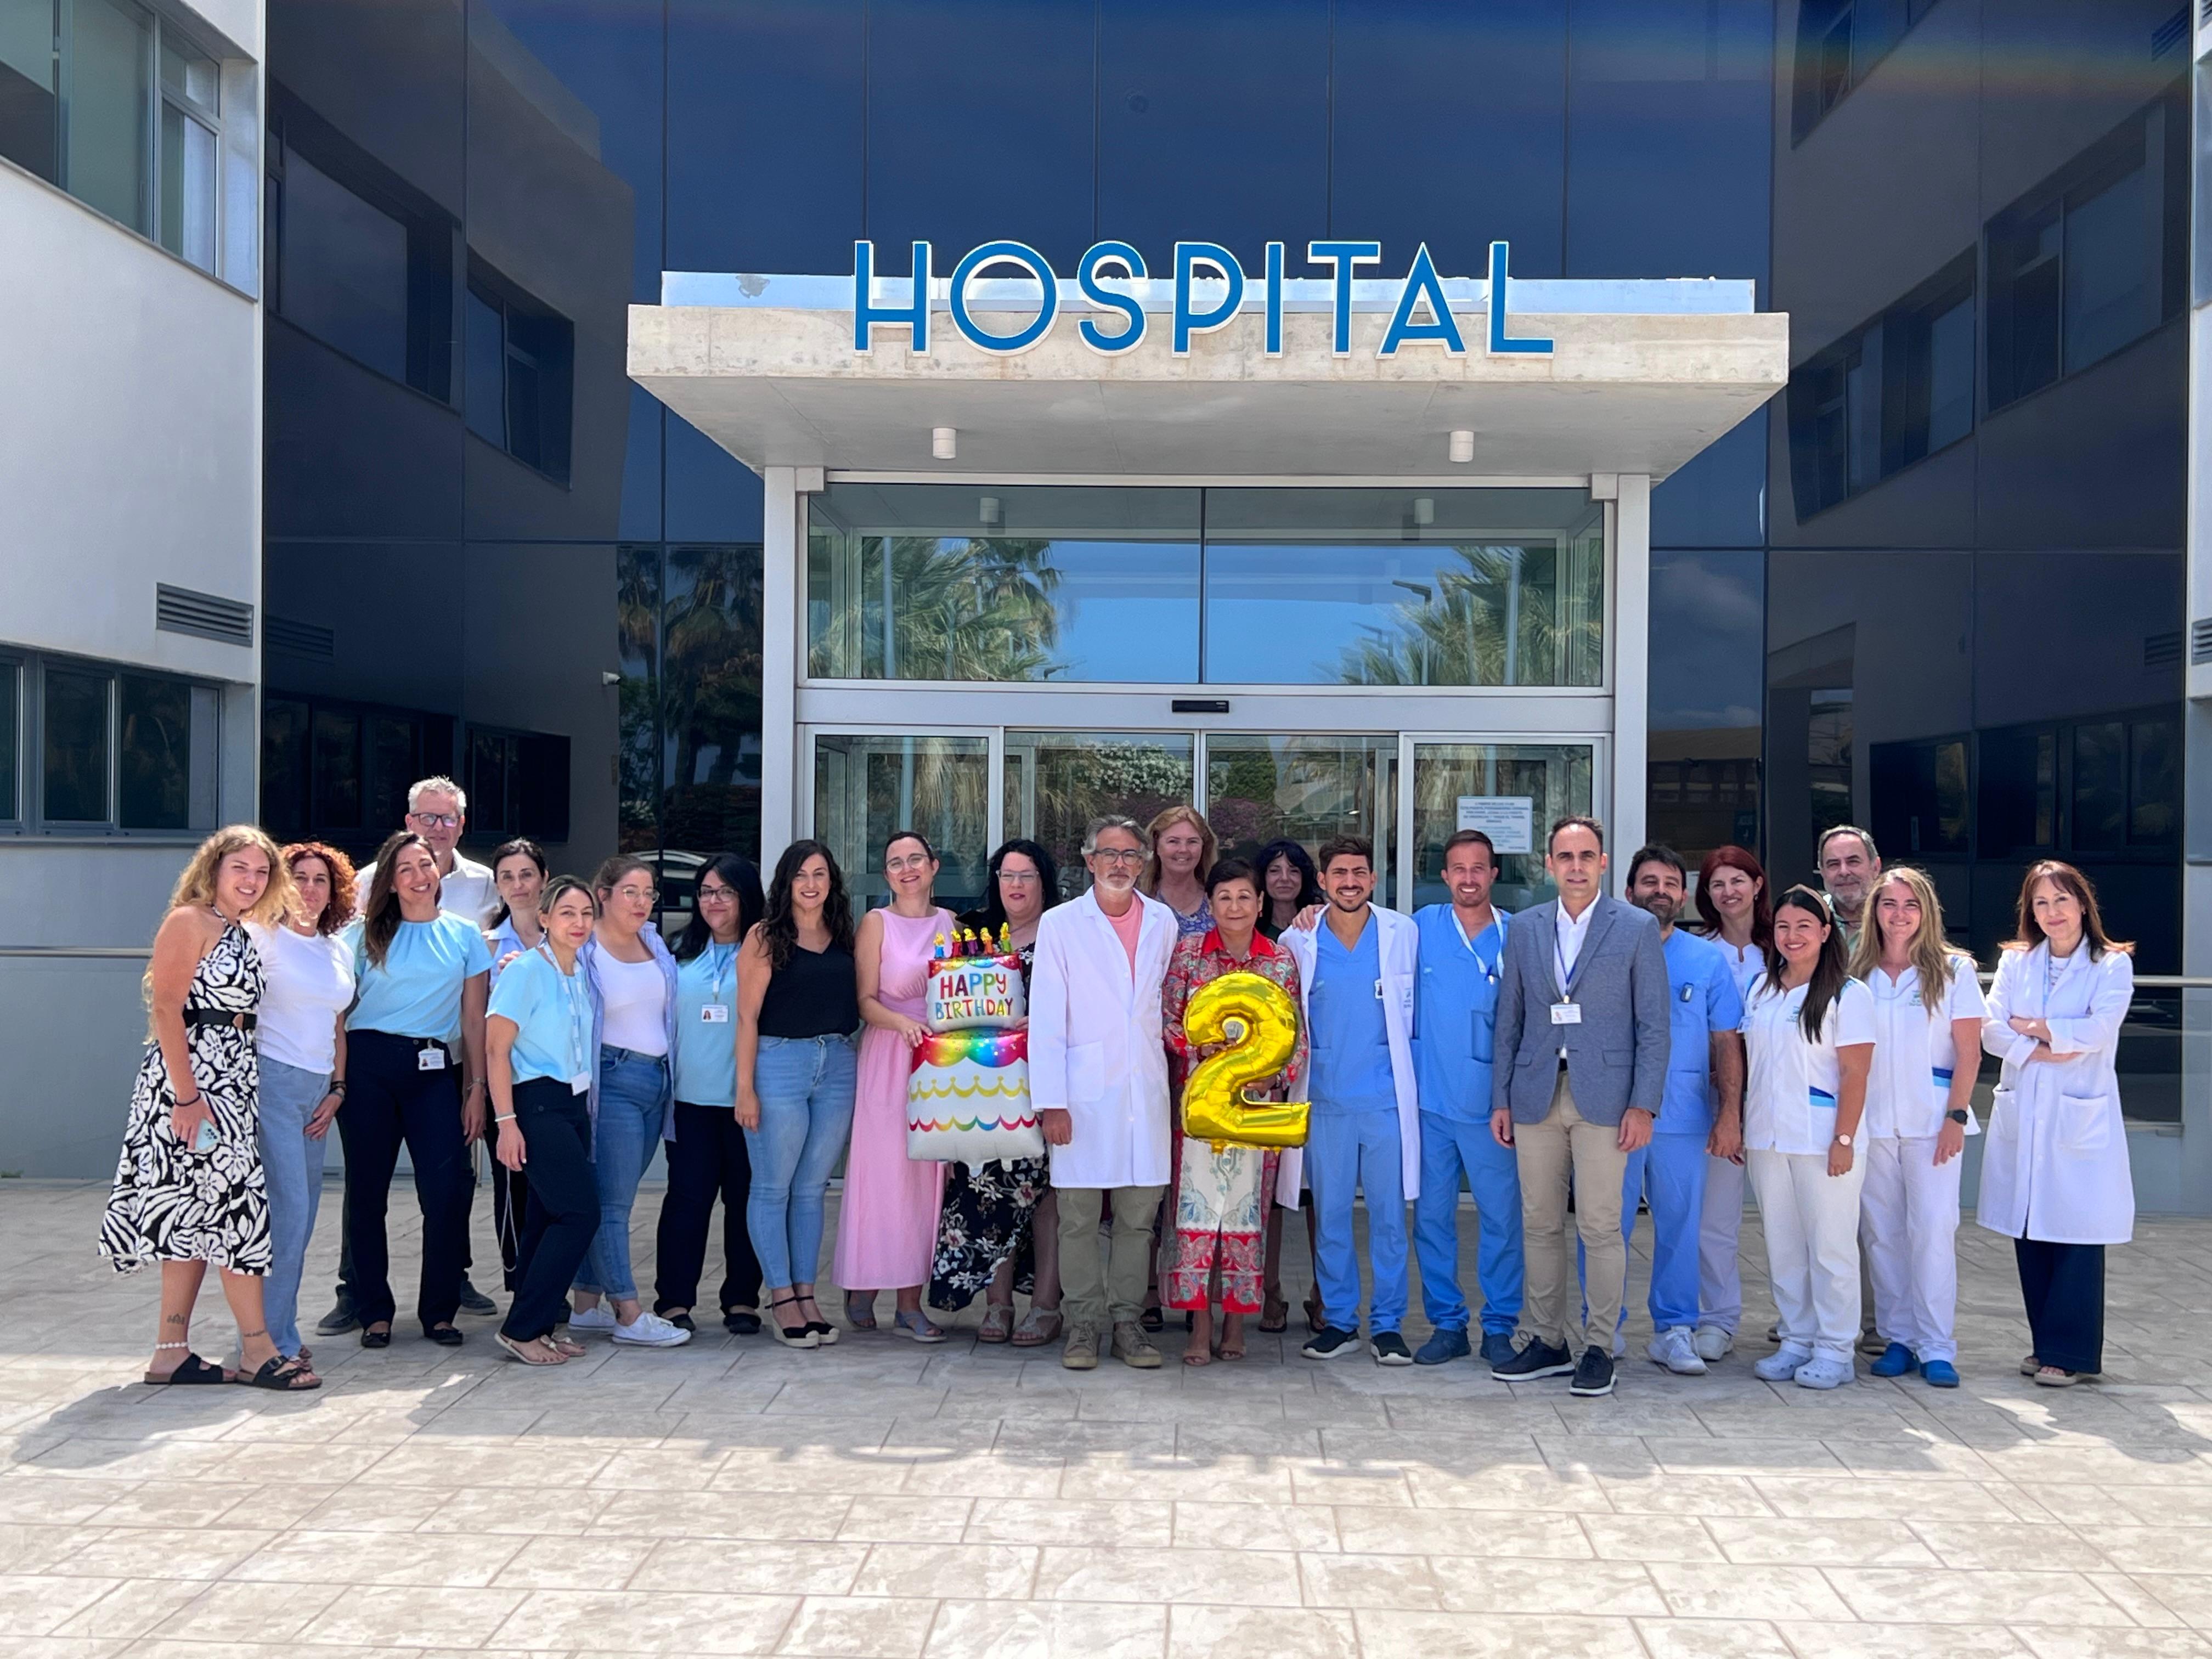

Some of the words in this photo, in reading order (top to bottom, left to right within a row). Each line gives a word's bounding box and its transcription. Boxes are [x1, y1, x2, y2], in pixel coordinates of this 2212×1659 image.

[854, 240, 1555, 359] HOSPITAL
[936, 998, 1013, 1019] BIRTHDAY
[940, 973, 1007, 1000] HAPPY
[1181, 970, 1311, 1148] 2
